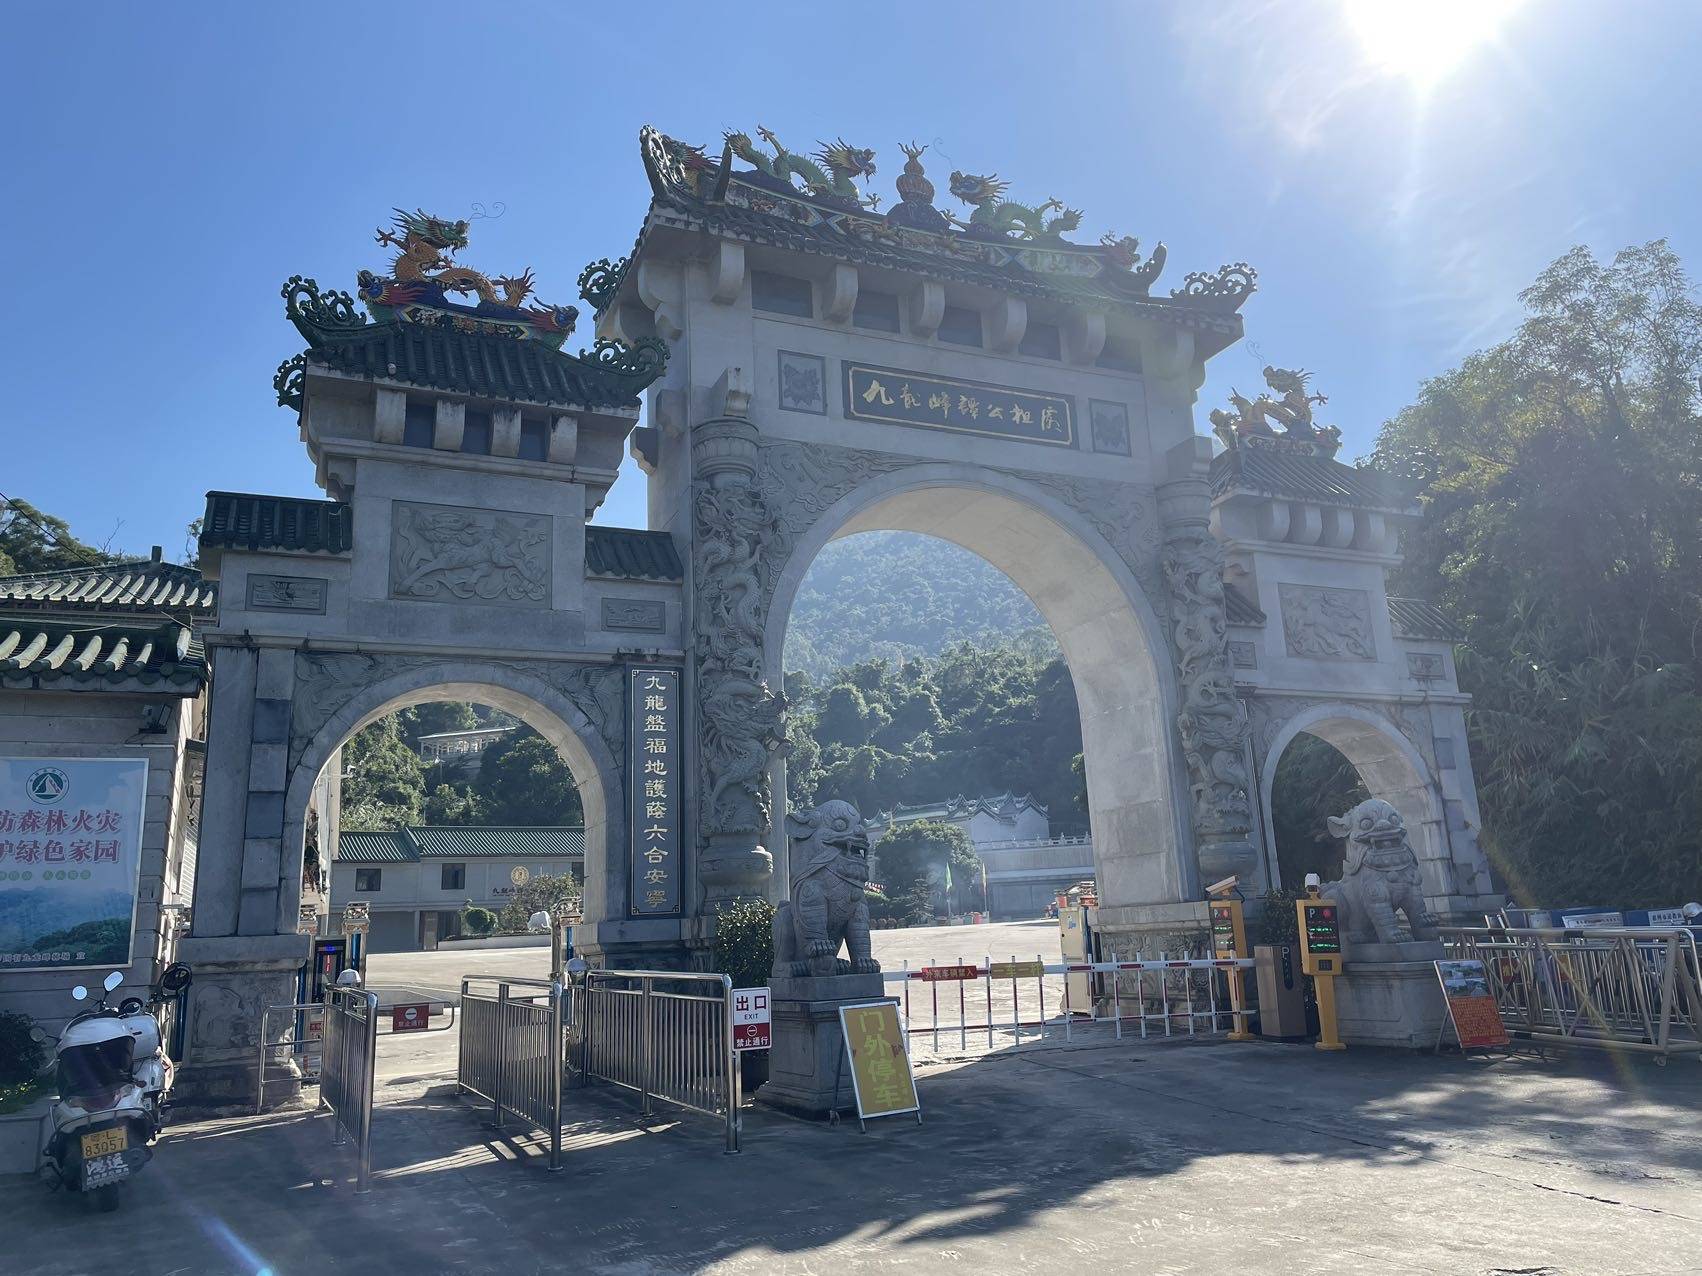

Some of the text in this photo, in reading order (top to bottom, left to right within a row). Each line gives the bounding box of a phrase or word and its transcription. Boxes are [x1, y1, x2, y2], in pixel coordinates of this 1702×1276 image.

[735, 995, 767, 1012] 出口
[736, 1036, 769, 1047] 禁止通行
[859, 1011, 902, 1107] 门外停车
[85, 1137, 124, 1157] 83057
